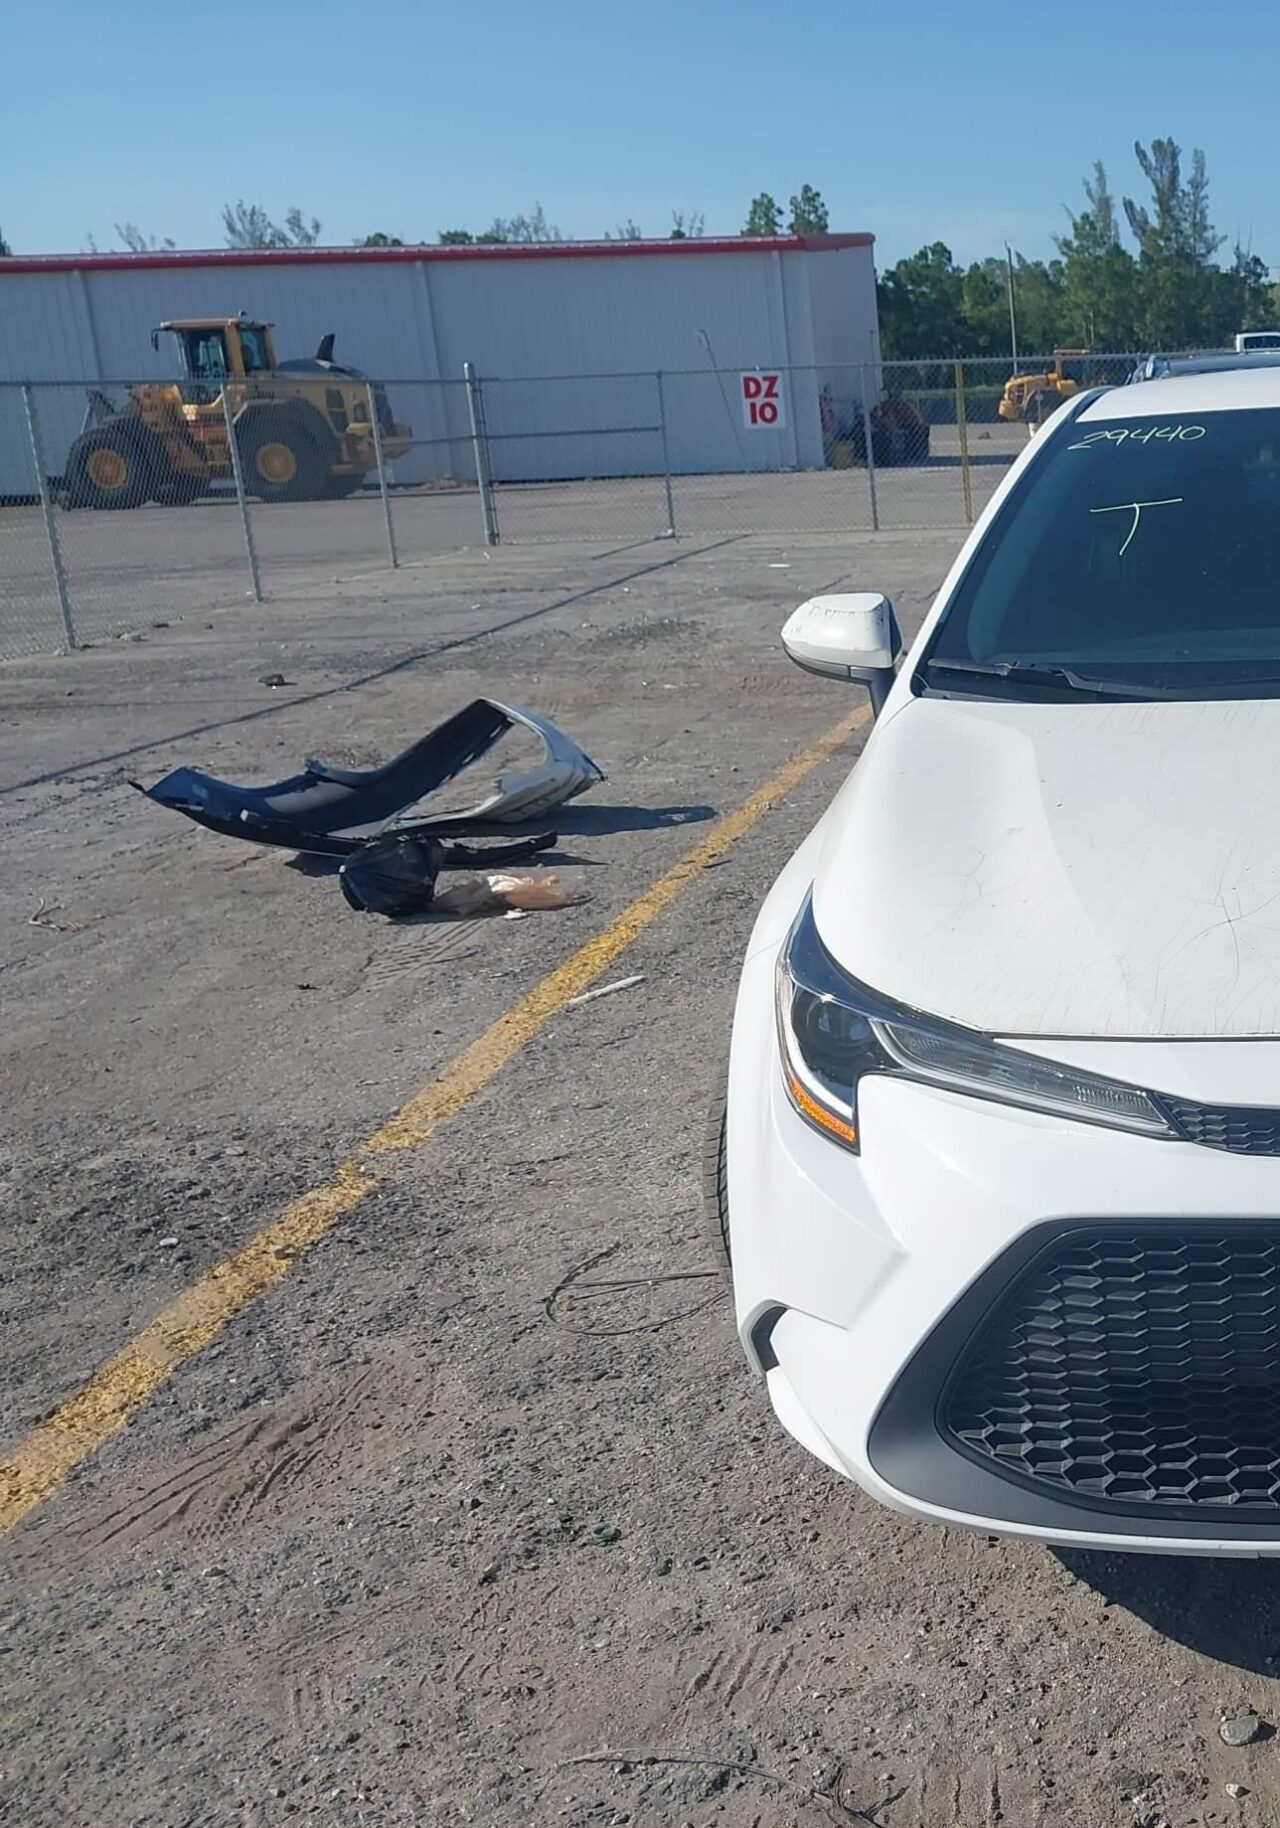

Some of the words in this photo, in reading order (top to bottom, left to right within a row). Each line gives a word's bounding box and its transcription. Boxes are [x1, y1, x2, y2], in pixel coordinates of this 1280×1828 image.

[743, 376, 779, 399] DZ
[1067, 426, 1206, 450] 29440
[1089, 498, 1183, 556] T
